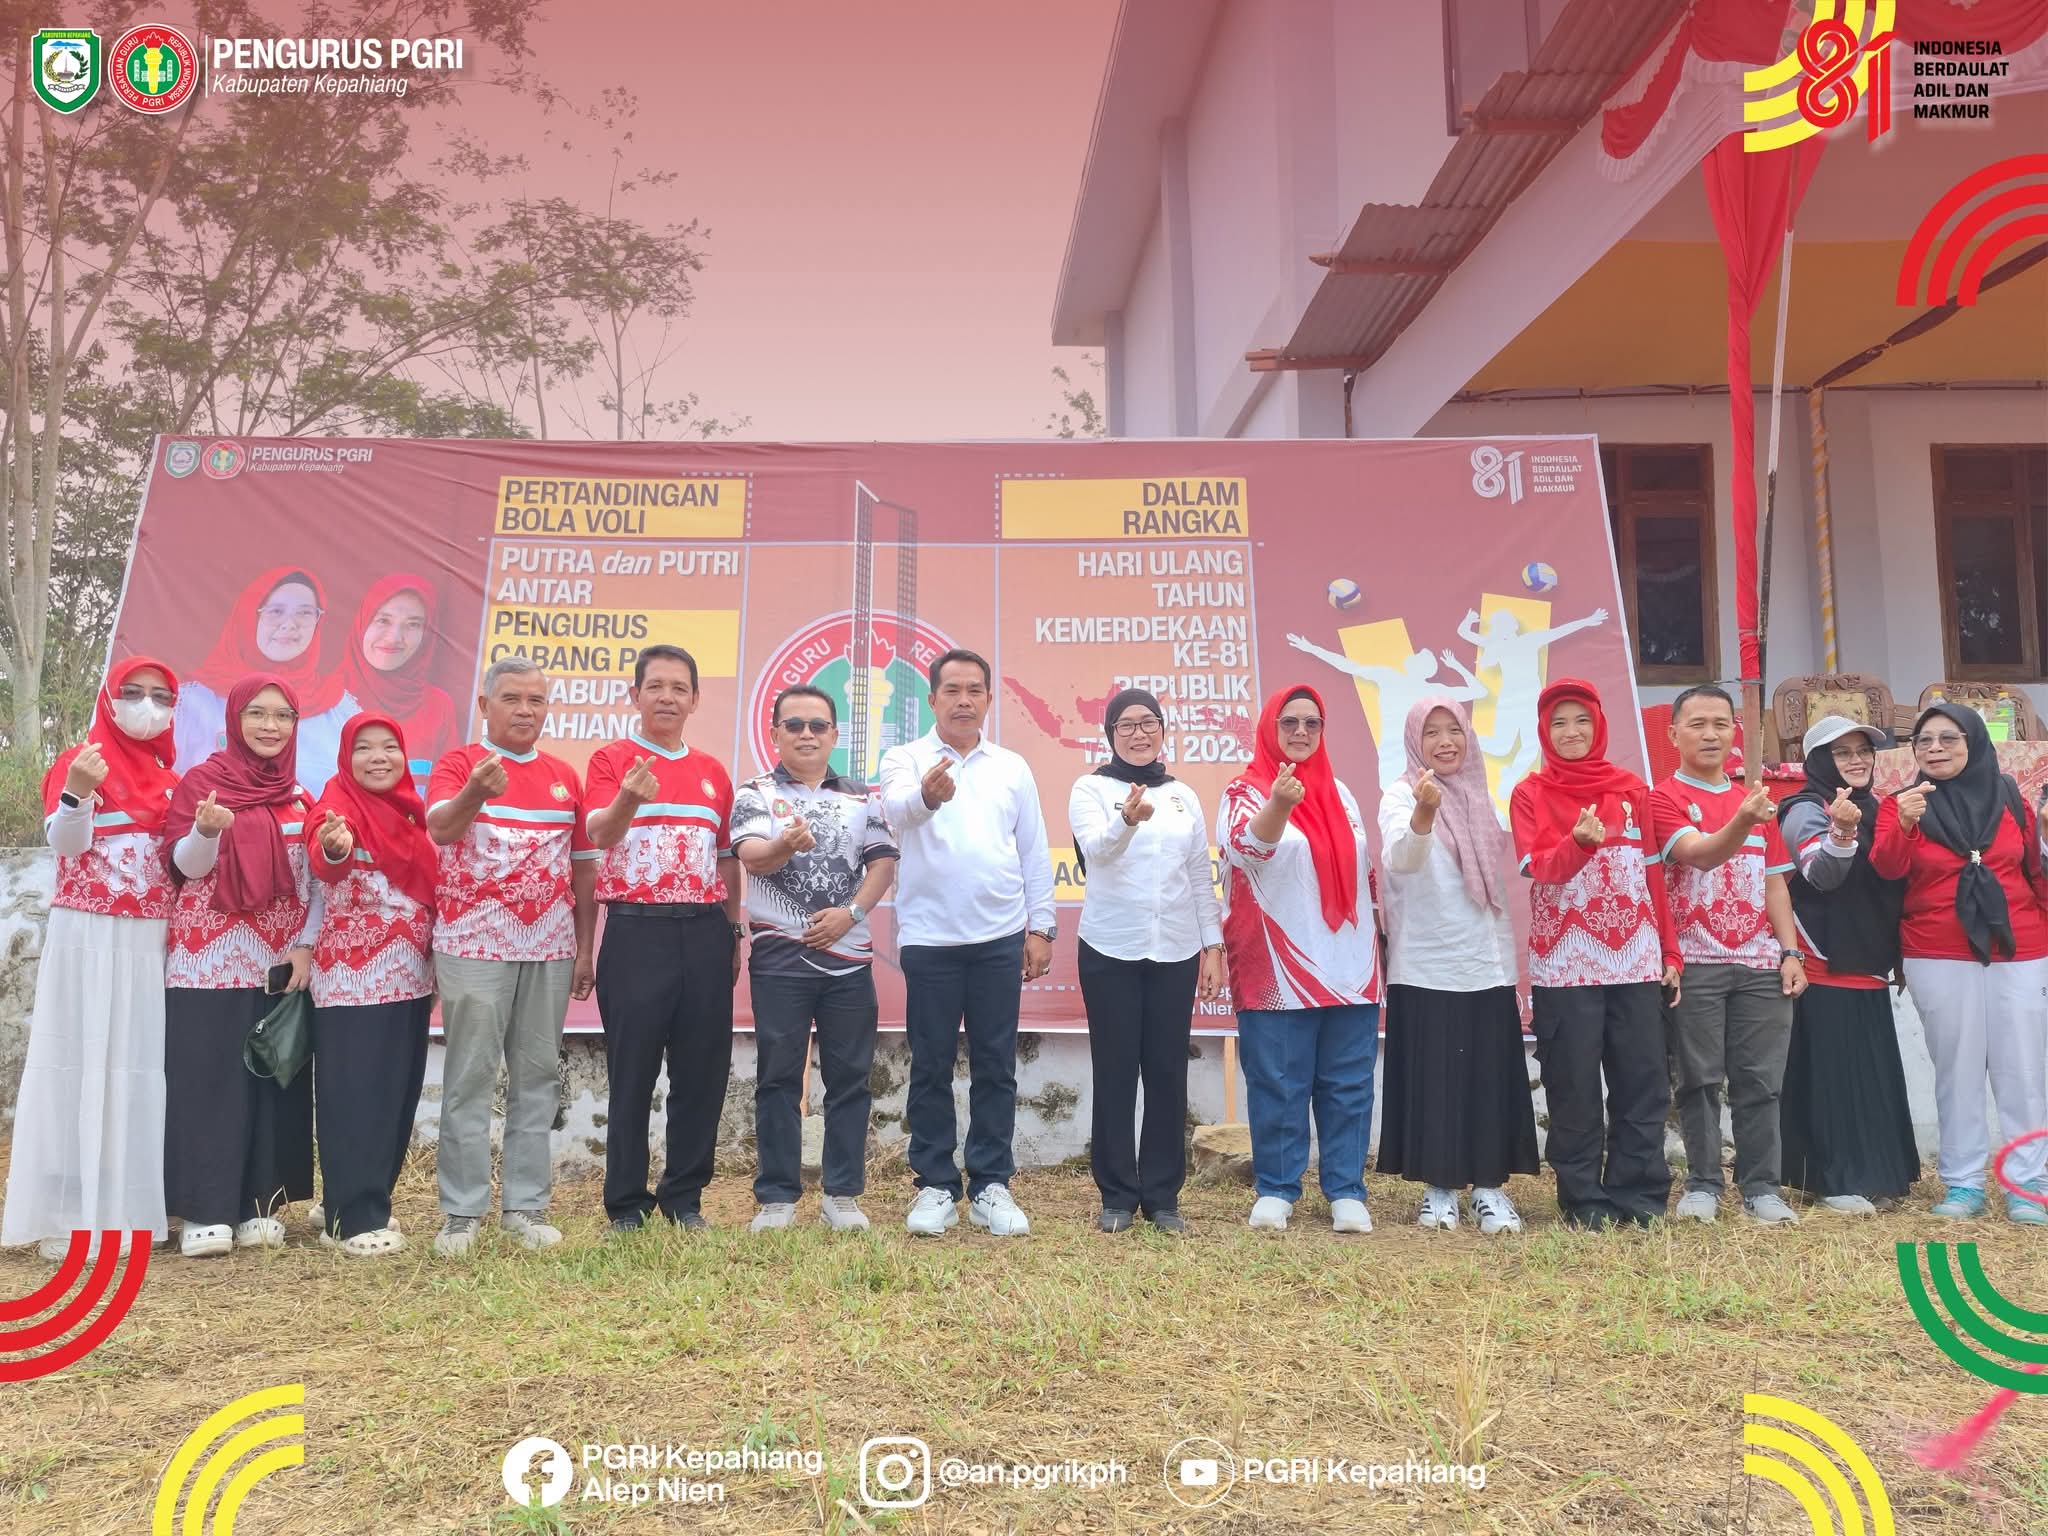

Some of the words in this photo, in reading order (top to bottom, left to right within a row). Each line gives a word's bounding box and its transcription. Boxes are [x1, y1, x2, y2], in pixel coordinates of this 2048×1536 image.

[250, 462, 297, 472] Kabupaten
[298, 462, 344, 473] Kepahiang
[252, 447, 334, 461] PENGURUS
[337, 448, 373, 462] PGRI
[1531, 455, 1578, 463] INDONESIA
[1470, 445, 1525, 504] 81
[1532, 465, 1582, 473] BERDAULAT
[1533, 475, 1552, 483] ADIL
[504, 480, 719, 507] PERTANDINGAN
[1143, 481, 1239, 506] DALAM
[1534, 484, 1575, 493] MAKMUR
[502, 507, 576, 532] BOLA
[585, 509, 645, 534] VOLI
[1123, 509, 1241, 535] RANGKA
[500, 547, 595, 574] PUTRA
[602, 550, 652, 575] dan
[658, 551, 739, 575] PUTRI
[1078, 551, 1142, 577] HARI
[1150, 550, 1243, 576] ULANG
[496, 578, 593, 604] ANTAR
[1152, 583, 1245, 608] TAHUN
[494, 611, 648, 639] PENGURUS
[1035, 615, 1247, 643] KEMERDEKAAN
[782, 638, 831, 685] GURU
[1173, 642, 1249, 667] KE-81
